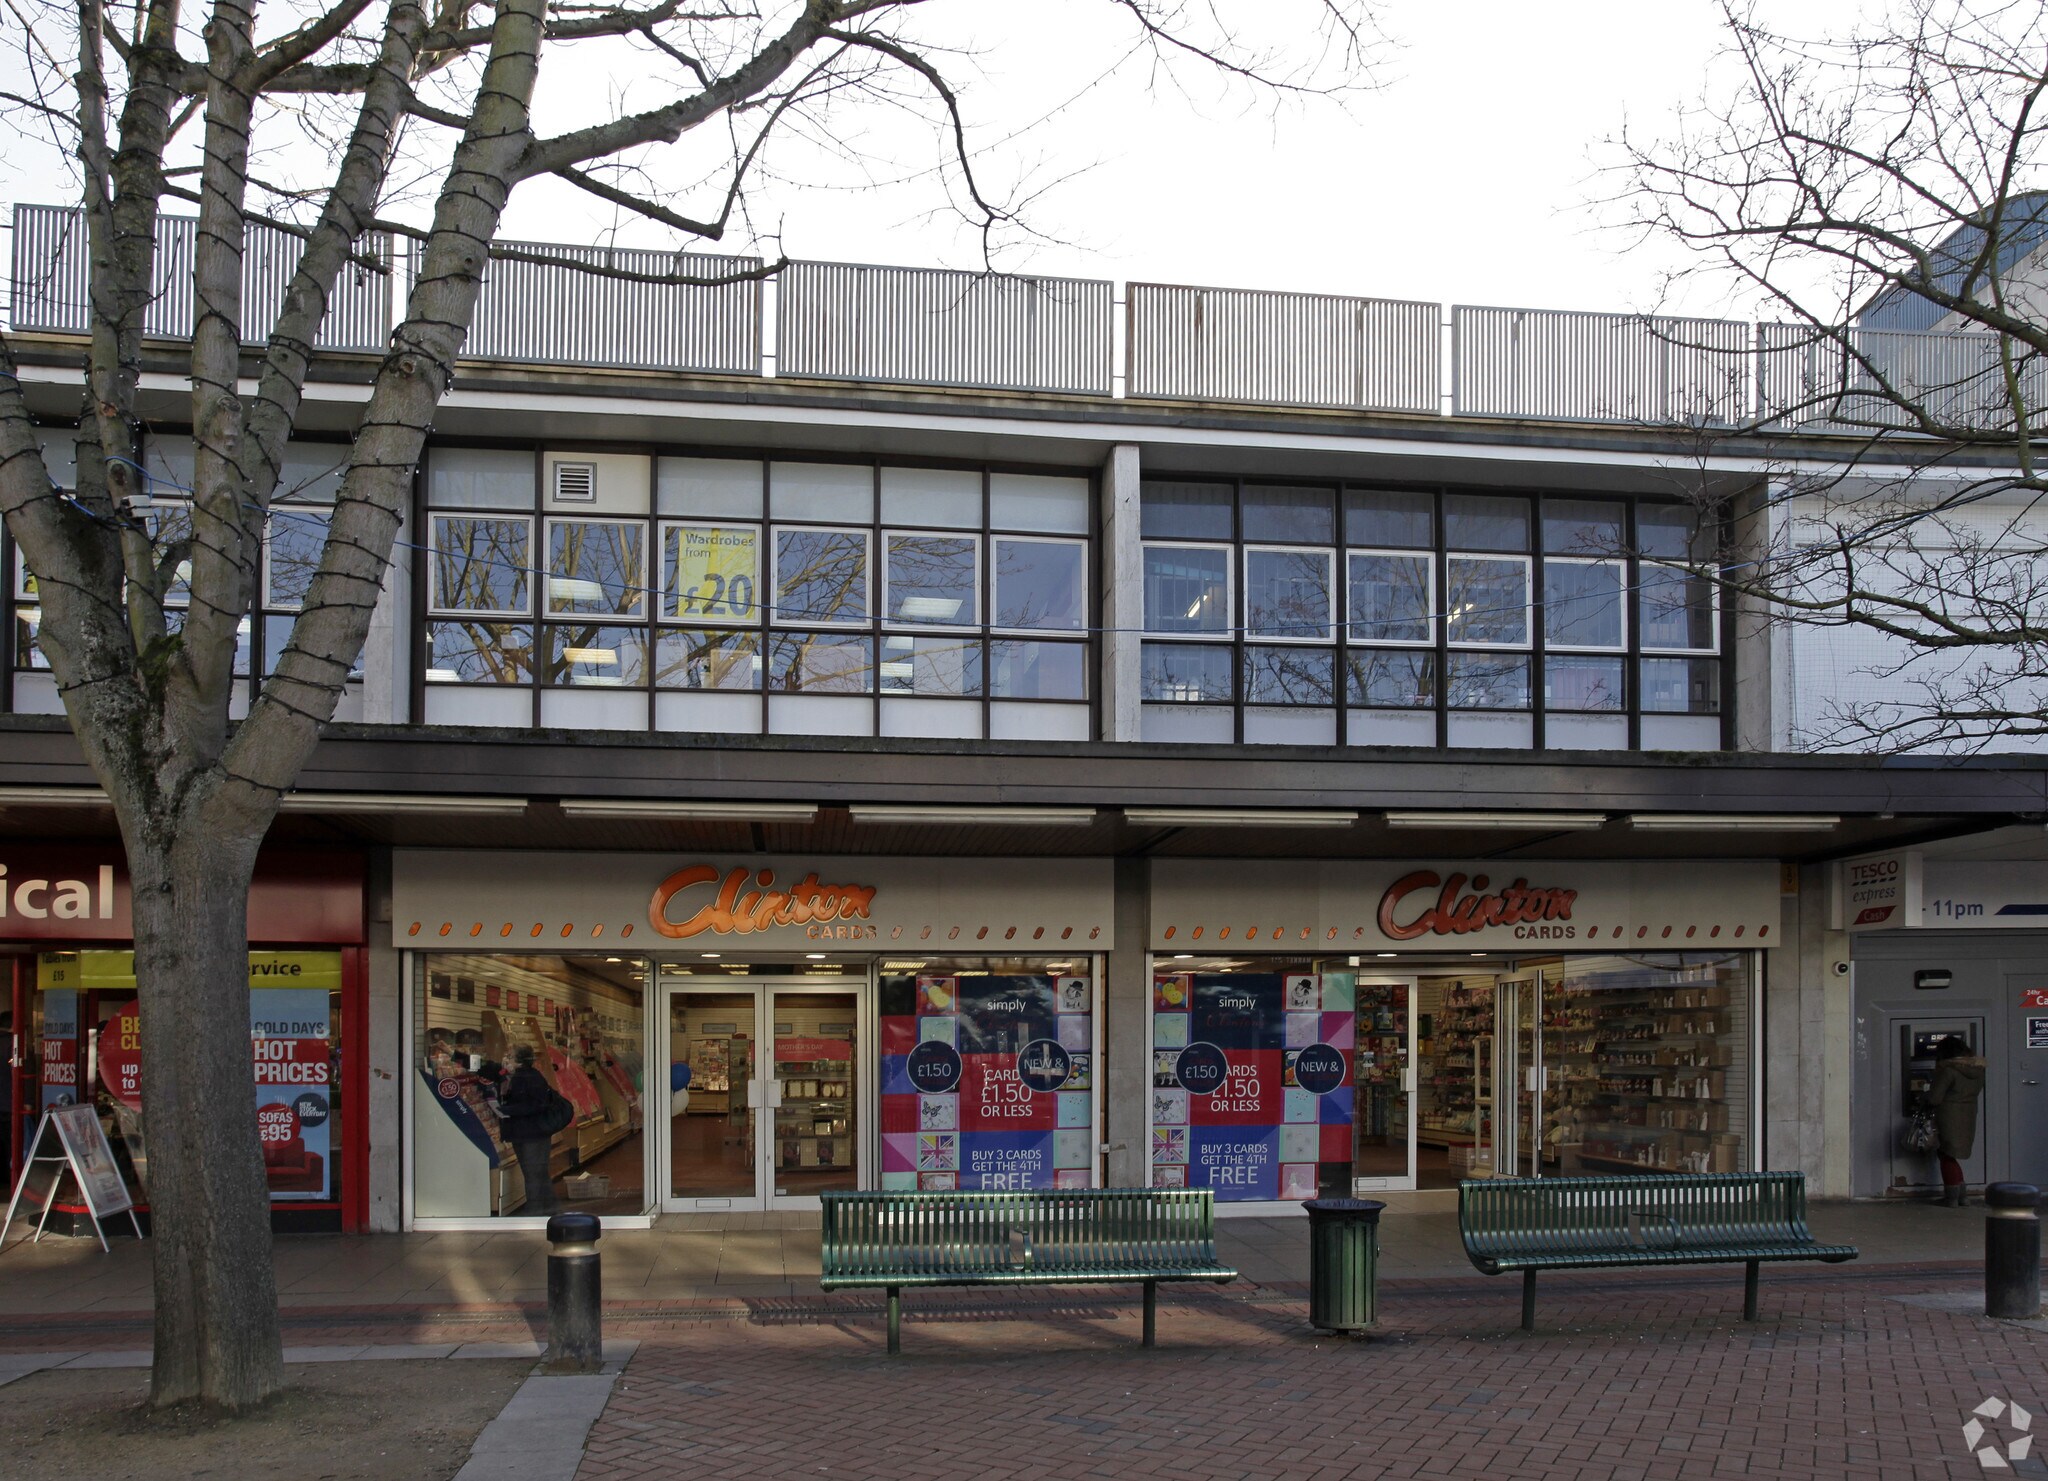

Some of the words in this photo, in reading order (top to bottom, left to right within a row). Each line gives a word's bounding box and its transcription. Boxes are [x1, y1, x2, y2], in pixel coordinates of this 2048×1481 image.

[686, 533, 754, 546] Wardrobes
[685, 547, 711, 558] from
[684, 573, 753, 616] £20
[1851, 860, 1898, 879] TESCO
[648, 864, 877, 939] Clinton
[1852, 887, 1896, 904] express
[1377, 870, 1578, 940] Clinton
[1933, 900, 1984, 919] 11pm
[1863, 910, 1885, 921] Cash
[805, 925, 877, 940] CARDS
[1514, 925, 1576, 939] CARDS
[249, 960, 302, 976] rvice
[52, 970, 65, 982] £15
[987, 999, 1027, 1013] simply
[1218, 996, 1256, 1010] simply
[45, 1022, 58, 1034] COLD
[59, 1022, 74, 1034] DAYS
[254, 1021, 288, 1034] COLD
[292, 1021, 325, 1034] DAYS
[44, 1041, 62, 1060] HOT
[254, 1040, 297, 1060] HOT
[121, 1064, 139, 1077] up
[917, 1063, 952, 1077] £1.50
[1023, 1058, 1052, 1070] NEW
[1054, 1057, 1065, 1069] &
[1300, 1061, 1328, 1073] NEW
[1329, 1061, 1340, 1073] &
[44, 1062, 76, 1083] PRICES
[254, 1062, 328, 1083] PRICES
[985, 1069, 1020, 1081] CARD
[1185, 1065, 1218, 1079] £1.50
[1226, 1065, 1257, 1077] ARDS
[122, 1077, 136, 1089] to
[981, 1083, 1032, 1103] £1.50
[981, 1105, 1000, 1117] OR
[1004, 1105, 1032, 1117] LESS
[1210, 1100, 1229, 1112] OR
[1233, 1100, 1260, 1112] LESS
[258, 1112, 293, 1123] SOFAS
[260, 1124, 292, 1141] £95
[972, 1150, 994, 1160] BUY
[996, 1150, 1004, 1160] 3
[1006, 1150, 1042, 1160] CARDS
[1201, 1144, 1222, 1154] BUY
[1224, 1143, 1232, 1154] 3
[1233, 1144, 1268, 1154] CARDS
[972, 1161, 994, 1171] GET
[996, 1161, 1017, 1171] THE
[1019, 1160, 1041, 1170] 4TH
[1200, 1155, 1221, 1165] GET
[1224, 1154, 1244, 1165] THE
[1246, 1154, 1267, 1165] 4TH
[981, 1172, 1033, 1191] FREE
[1209, 1166, 1259, 1185] FREE
